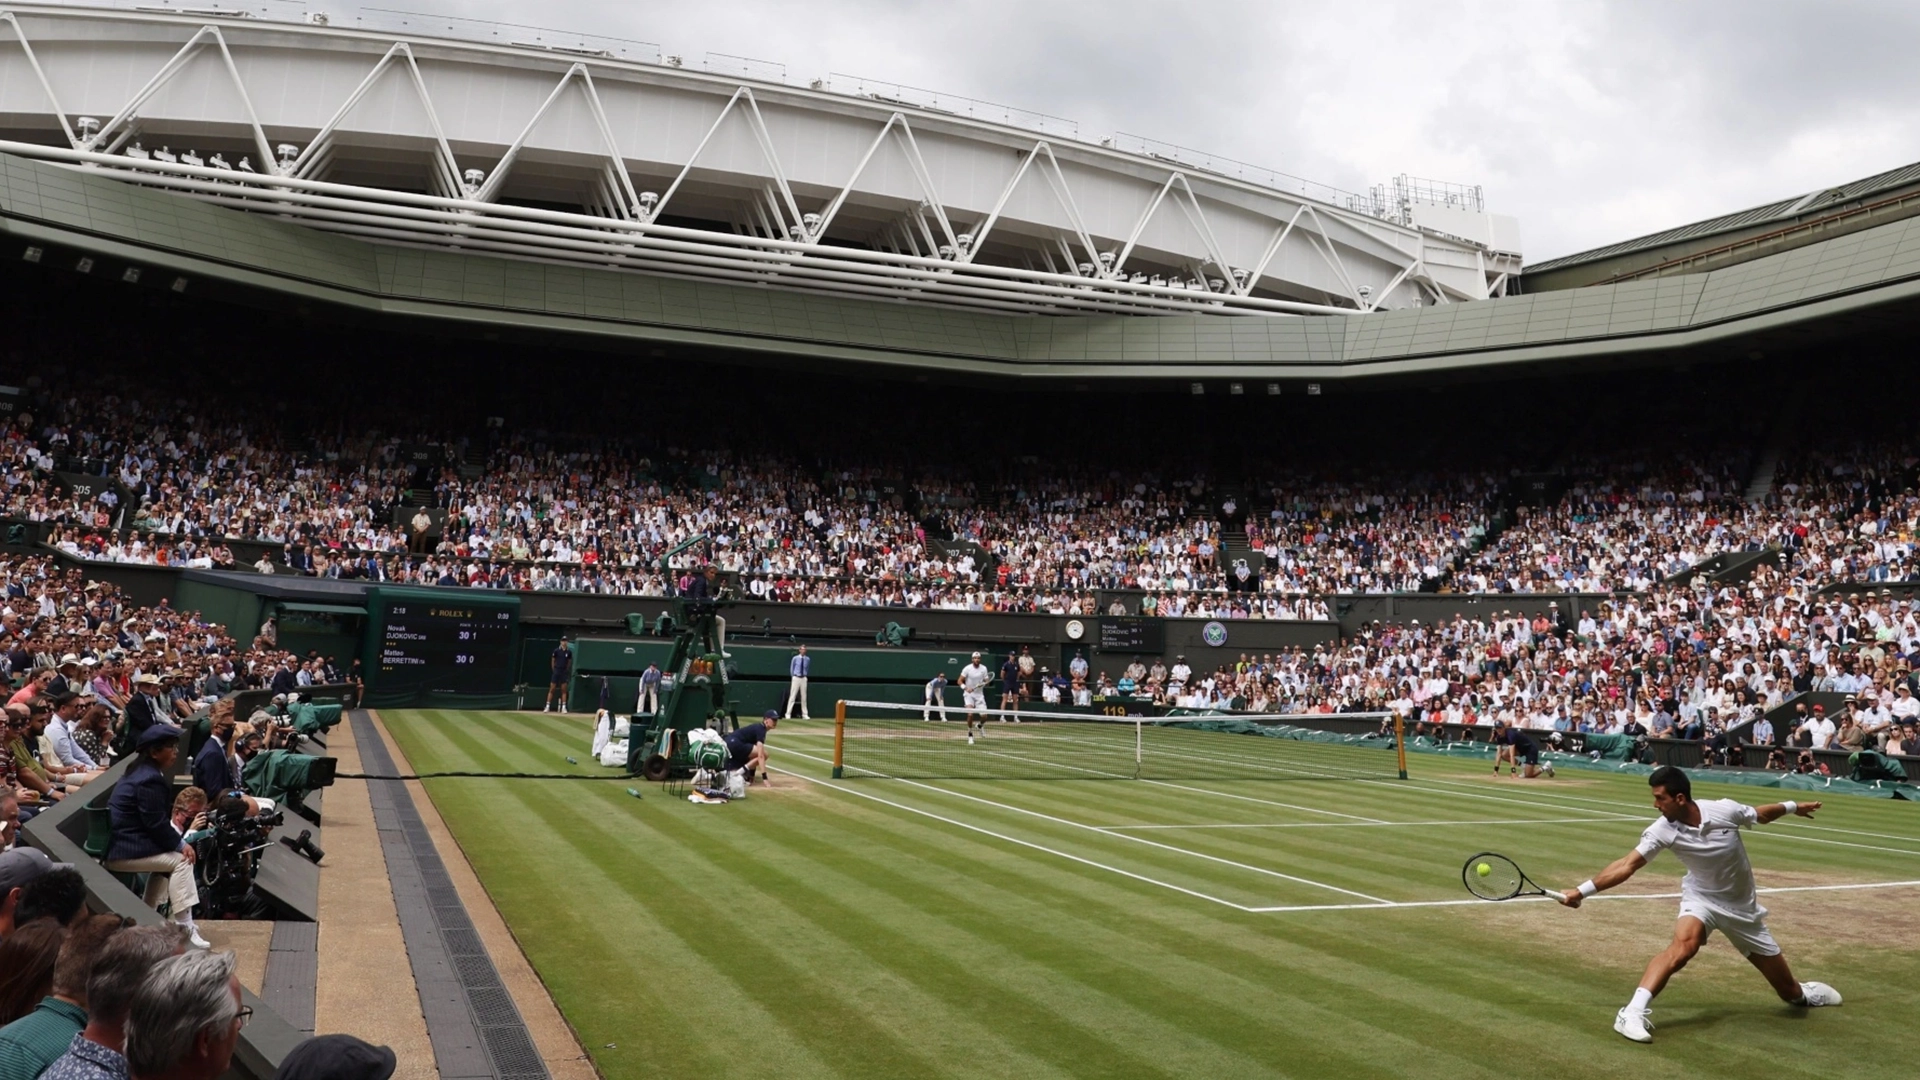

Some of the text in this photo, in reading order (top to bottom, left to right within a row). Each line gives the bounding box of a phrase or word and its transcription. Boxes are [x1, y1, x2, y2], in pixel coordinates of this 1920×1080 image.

[0, 402, 13, 411] 08
[386, 632, 418, 640] DJOKOVIC
[459, 632, 477, 640] 30 1
[383, 649, 404, 657] Matteo
[456, 655, 467, 663] 30
[1103, 706, 1126, 717] 119
